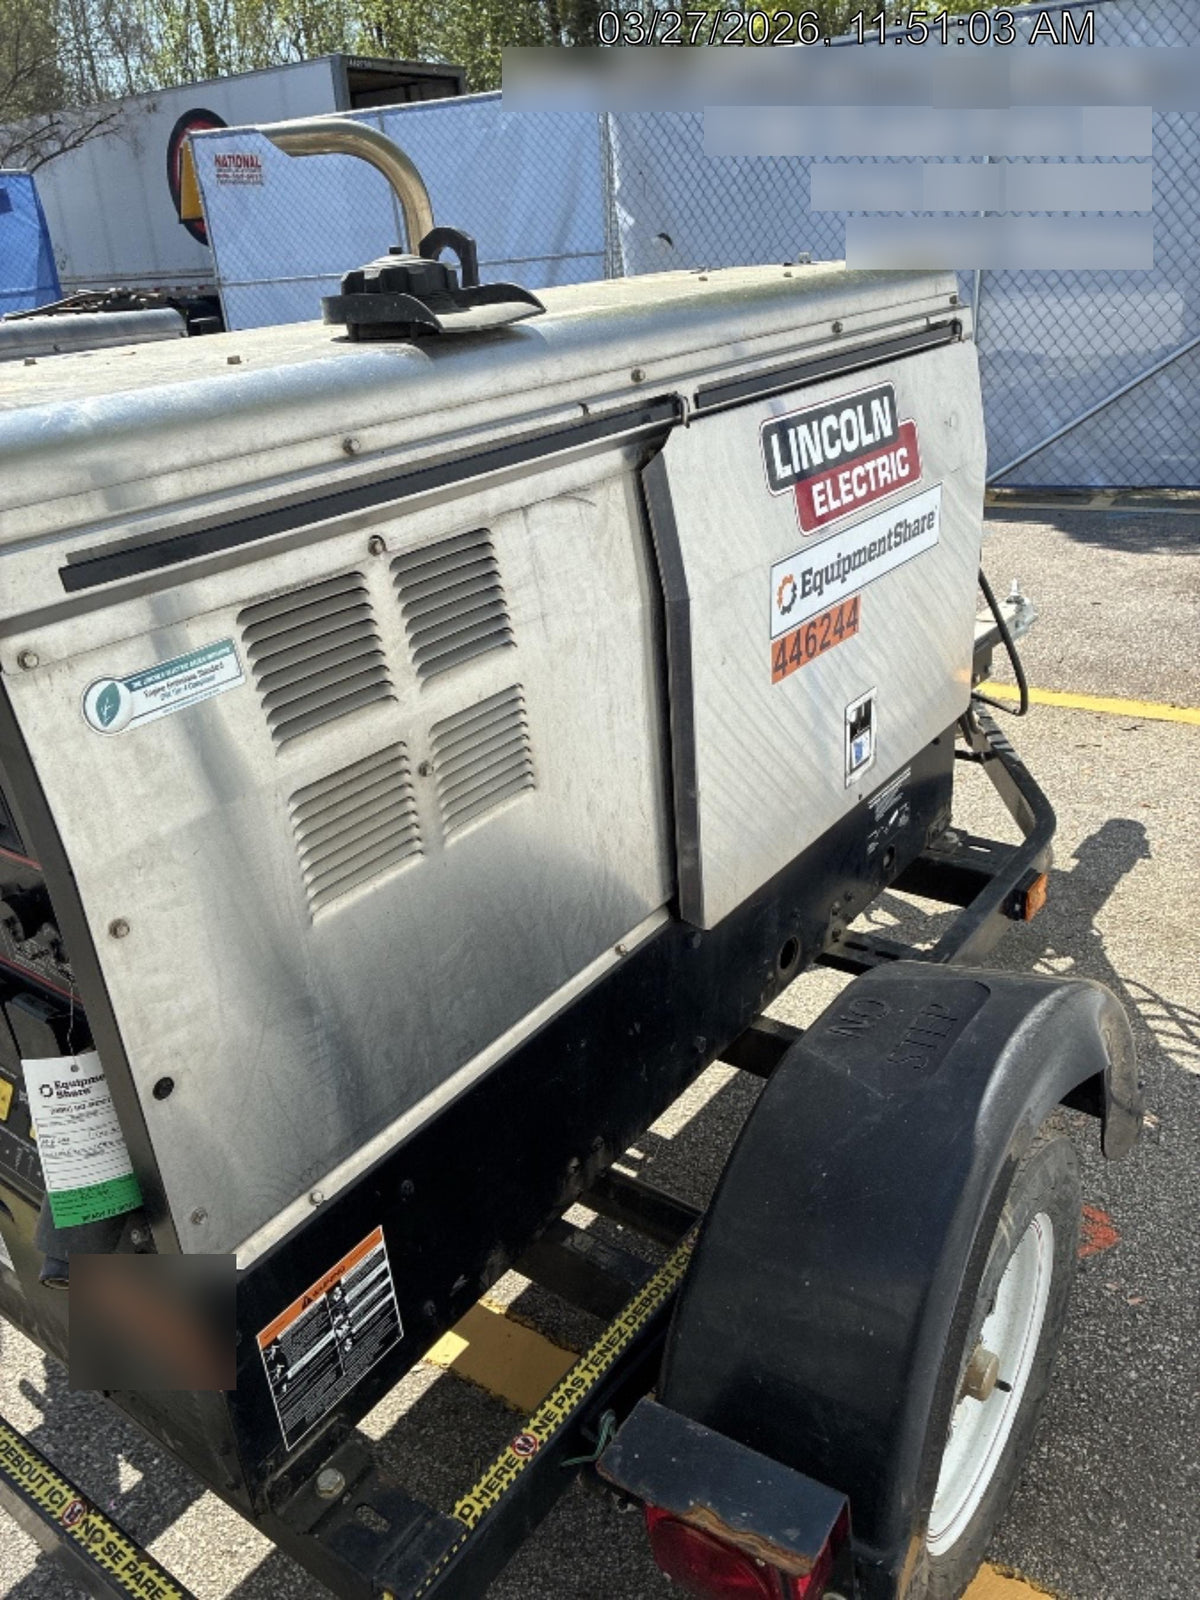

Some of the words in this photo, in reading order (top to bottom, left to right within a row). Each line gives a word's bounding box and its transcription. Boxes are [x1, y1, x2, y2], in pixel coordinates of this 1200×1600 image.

[214, 154, 262, 168] NATIONAL
[770, 395, 893, 481] LINCOLN
[812, 446, 911, 518] ELECTRIC
[799, 511, 936, 600] EquipmentShare
[772, 601, 858, 676] 446244
[828, 997, 891, 1038] NO
[532, 1407, 558, 1435] NE
[556, 1376, 588, 1412] PAS
[581, 1328, 627, 1374] TENEZ
[623, 1268, 674, 1327] DEBOUT
[0, 1440, 49, 1488] DEBOUT
[44, 1486, 67, 1510] ICI
[474, 1454, 519, 1502] HERE
[79, 1519, 106, 1544] NO
[101, 1542, 127, 1565] SE
[122, 1562, 168, 1600] PARE
